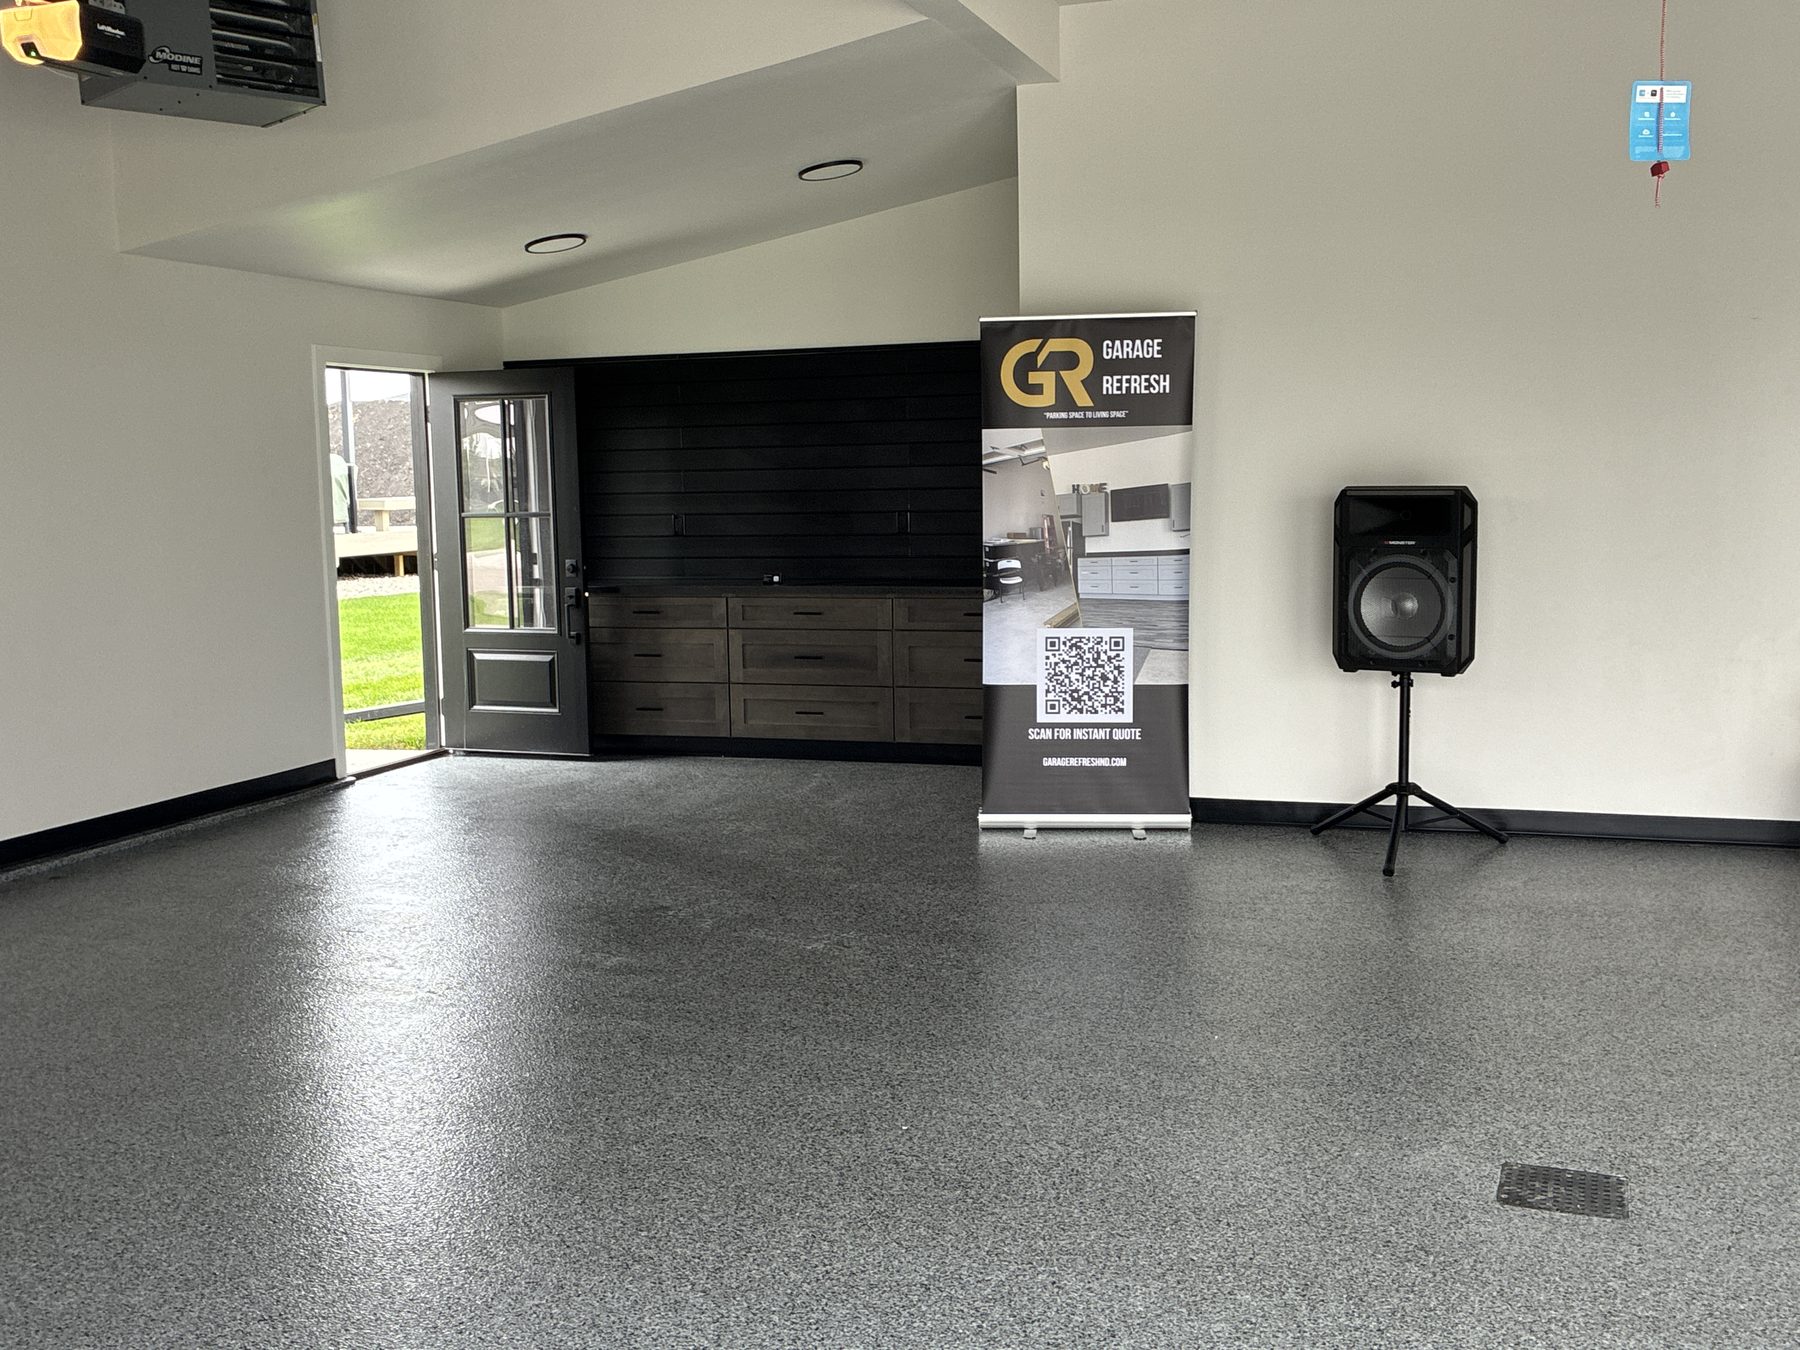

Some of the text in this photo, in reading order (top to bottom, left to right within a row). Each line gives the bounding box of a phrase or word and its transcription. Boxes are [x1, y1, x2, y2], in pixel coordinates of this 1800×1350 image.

[156, 51, 202, 65] MODINE
[1102, 339, 1163, 360] GARAGE
[1102, 374, 1170, 395] REFRESH
[1069, 411, 1084, 419] SPACE
[1093, 410, 1109, 418] LIVING
[1071, 483, 1108, 494] HOME
[1028, 728, 1142, 740] SCAN FOR INSTANT QUOTE
[1042, 757, 1127, 767] GARAGEREFRESHND.COM
